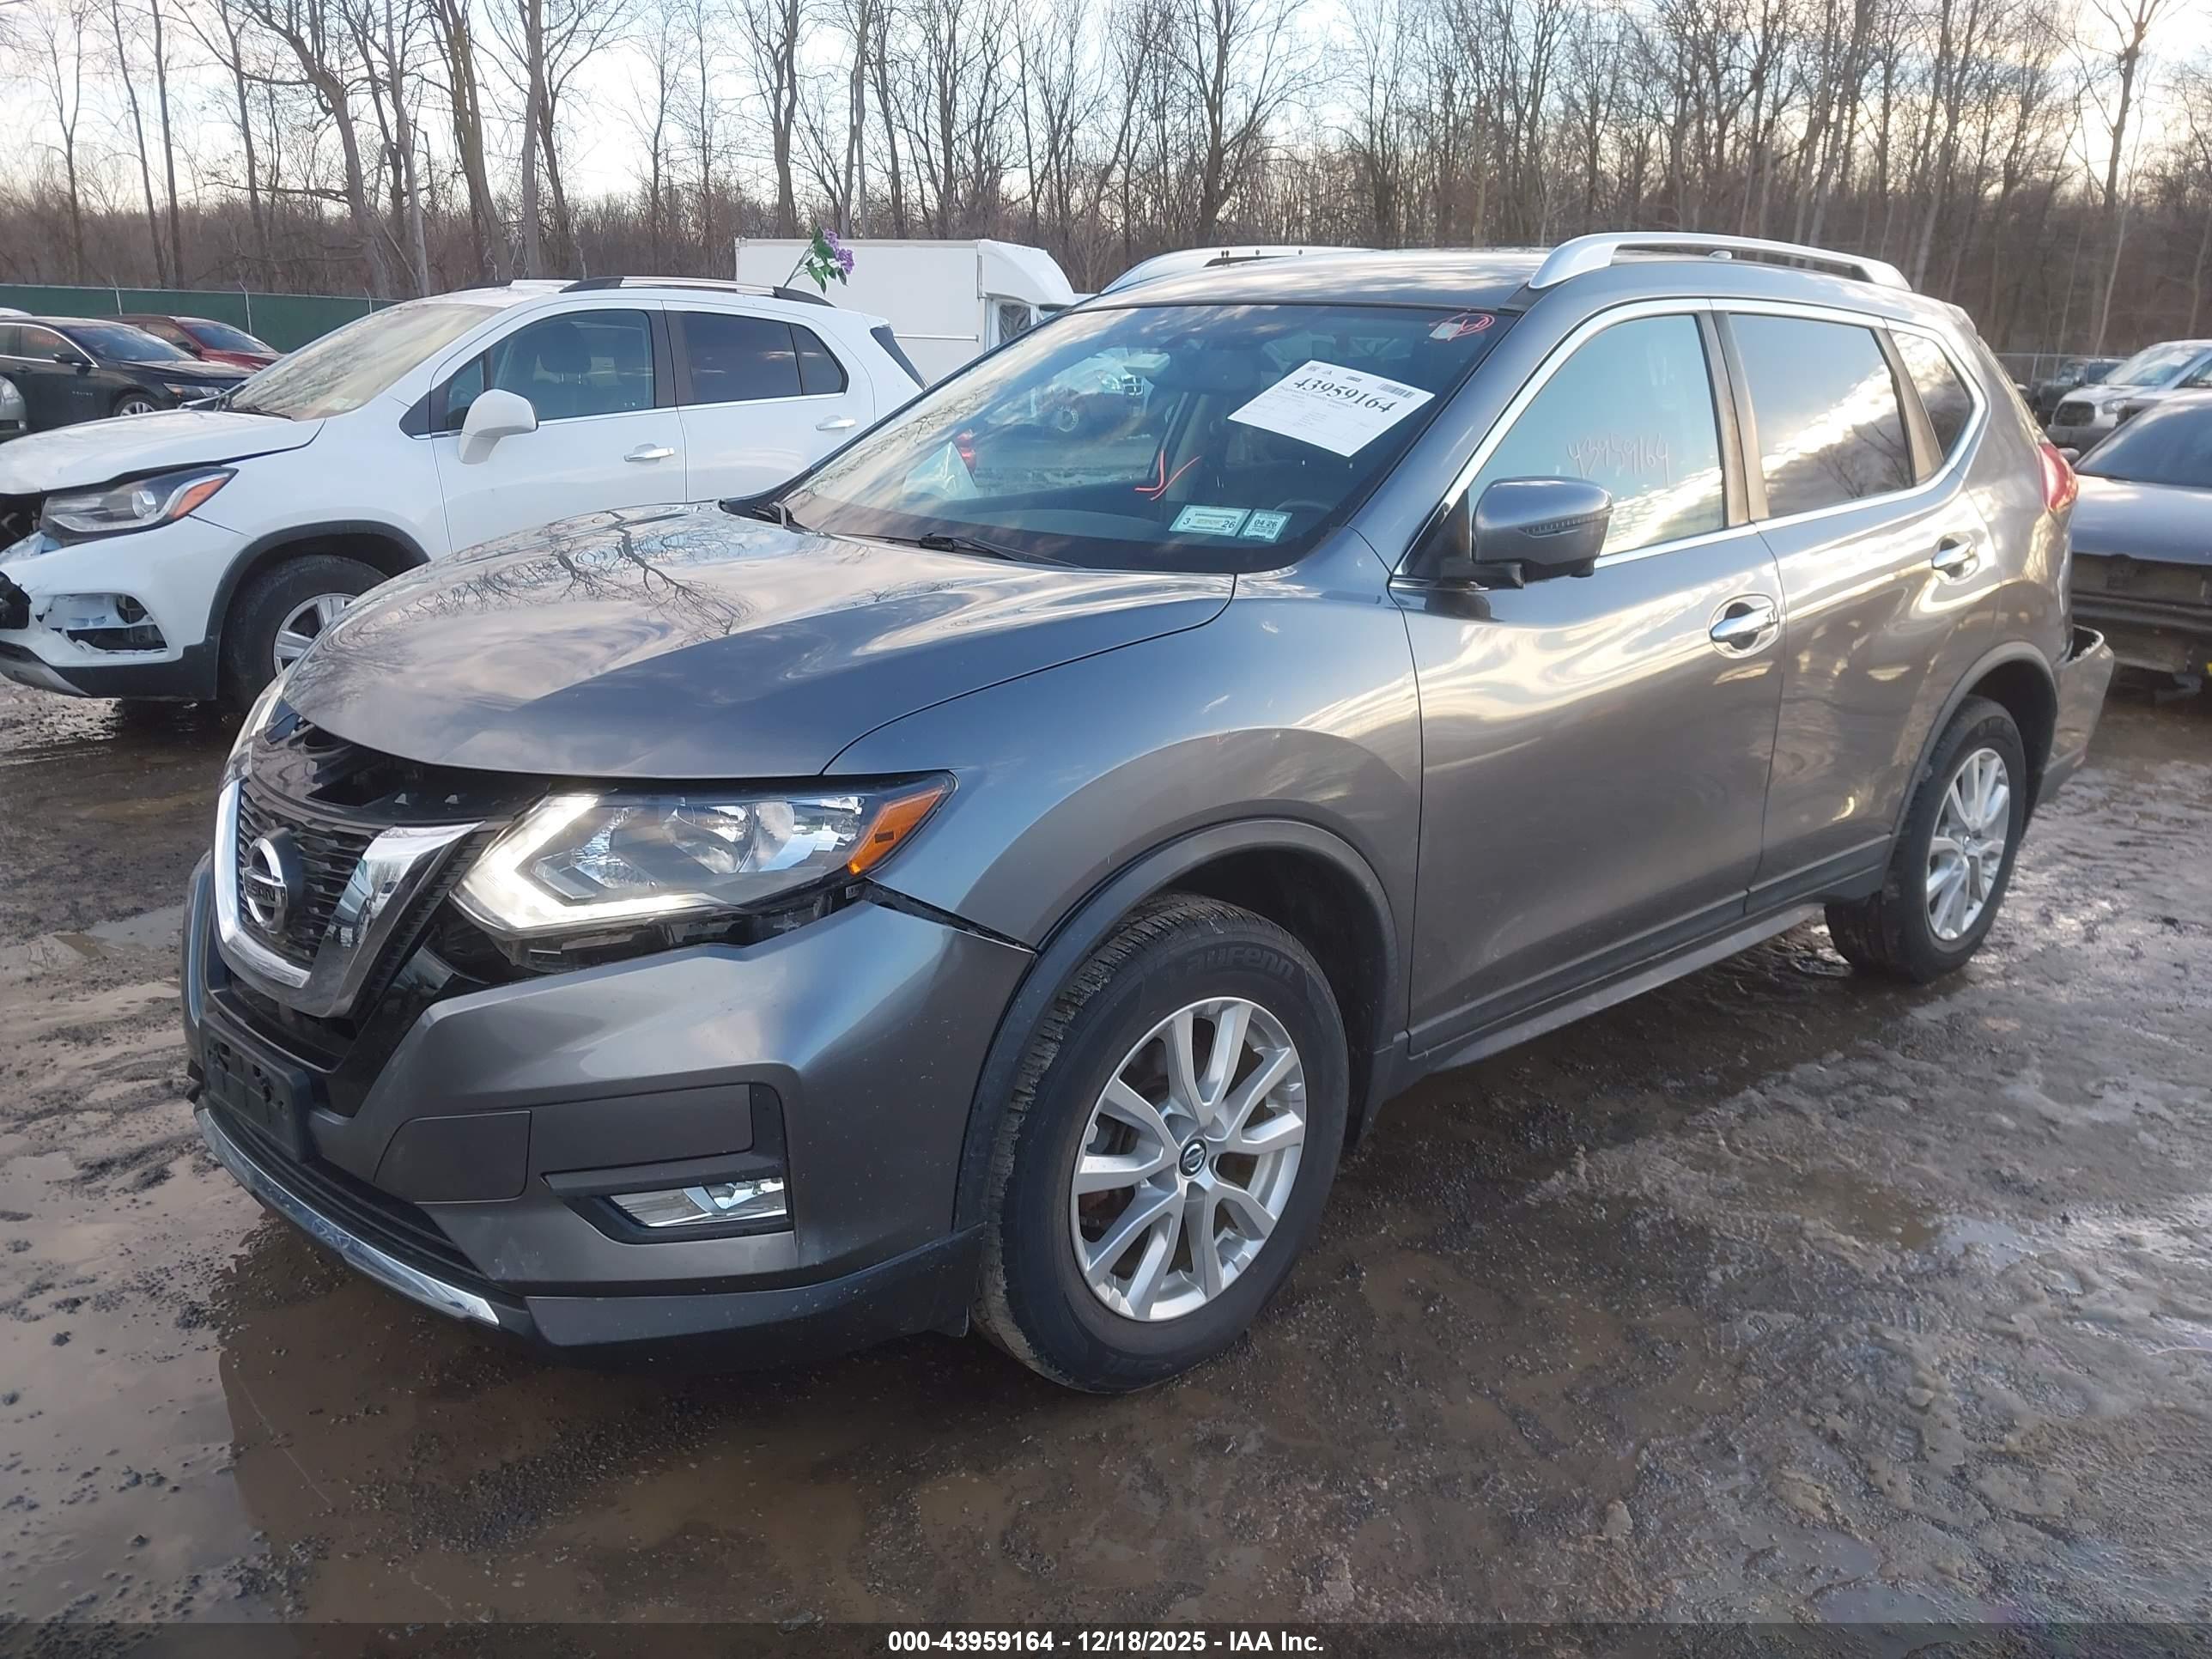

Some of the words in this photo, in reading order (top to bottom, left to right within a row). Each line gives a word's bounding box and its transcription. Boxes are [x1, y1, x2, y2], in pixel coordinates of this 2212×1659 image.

[1294, 378, 1397, 412] 43959164
[1566, 433, 1669, 489] 43959164
[1221, 520, 1236, 529] 26
